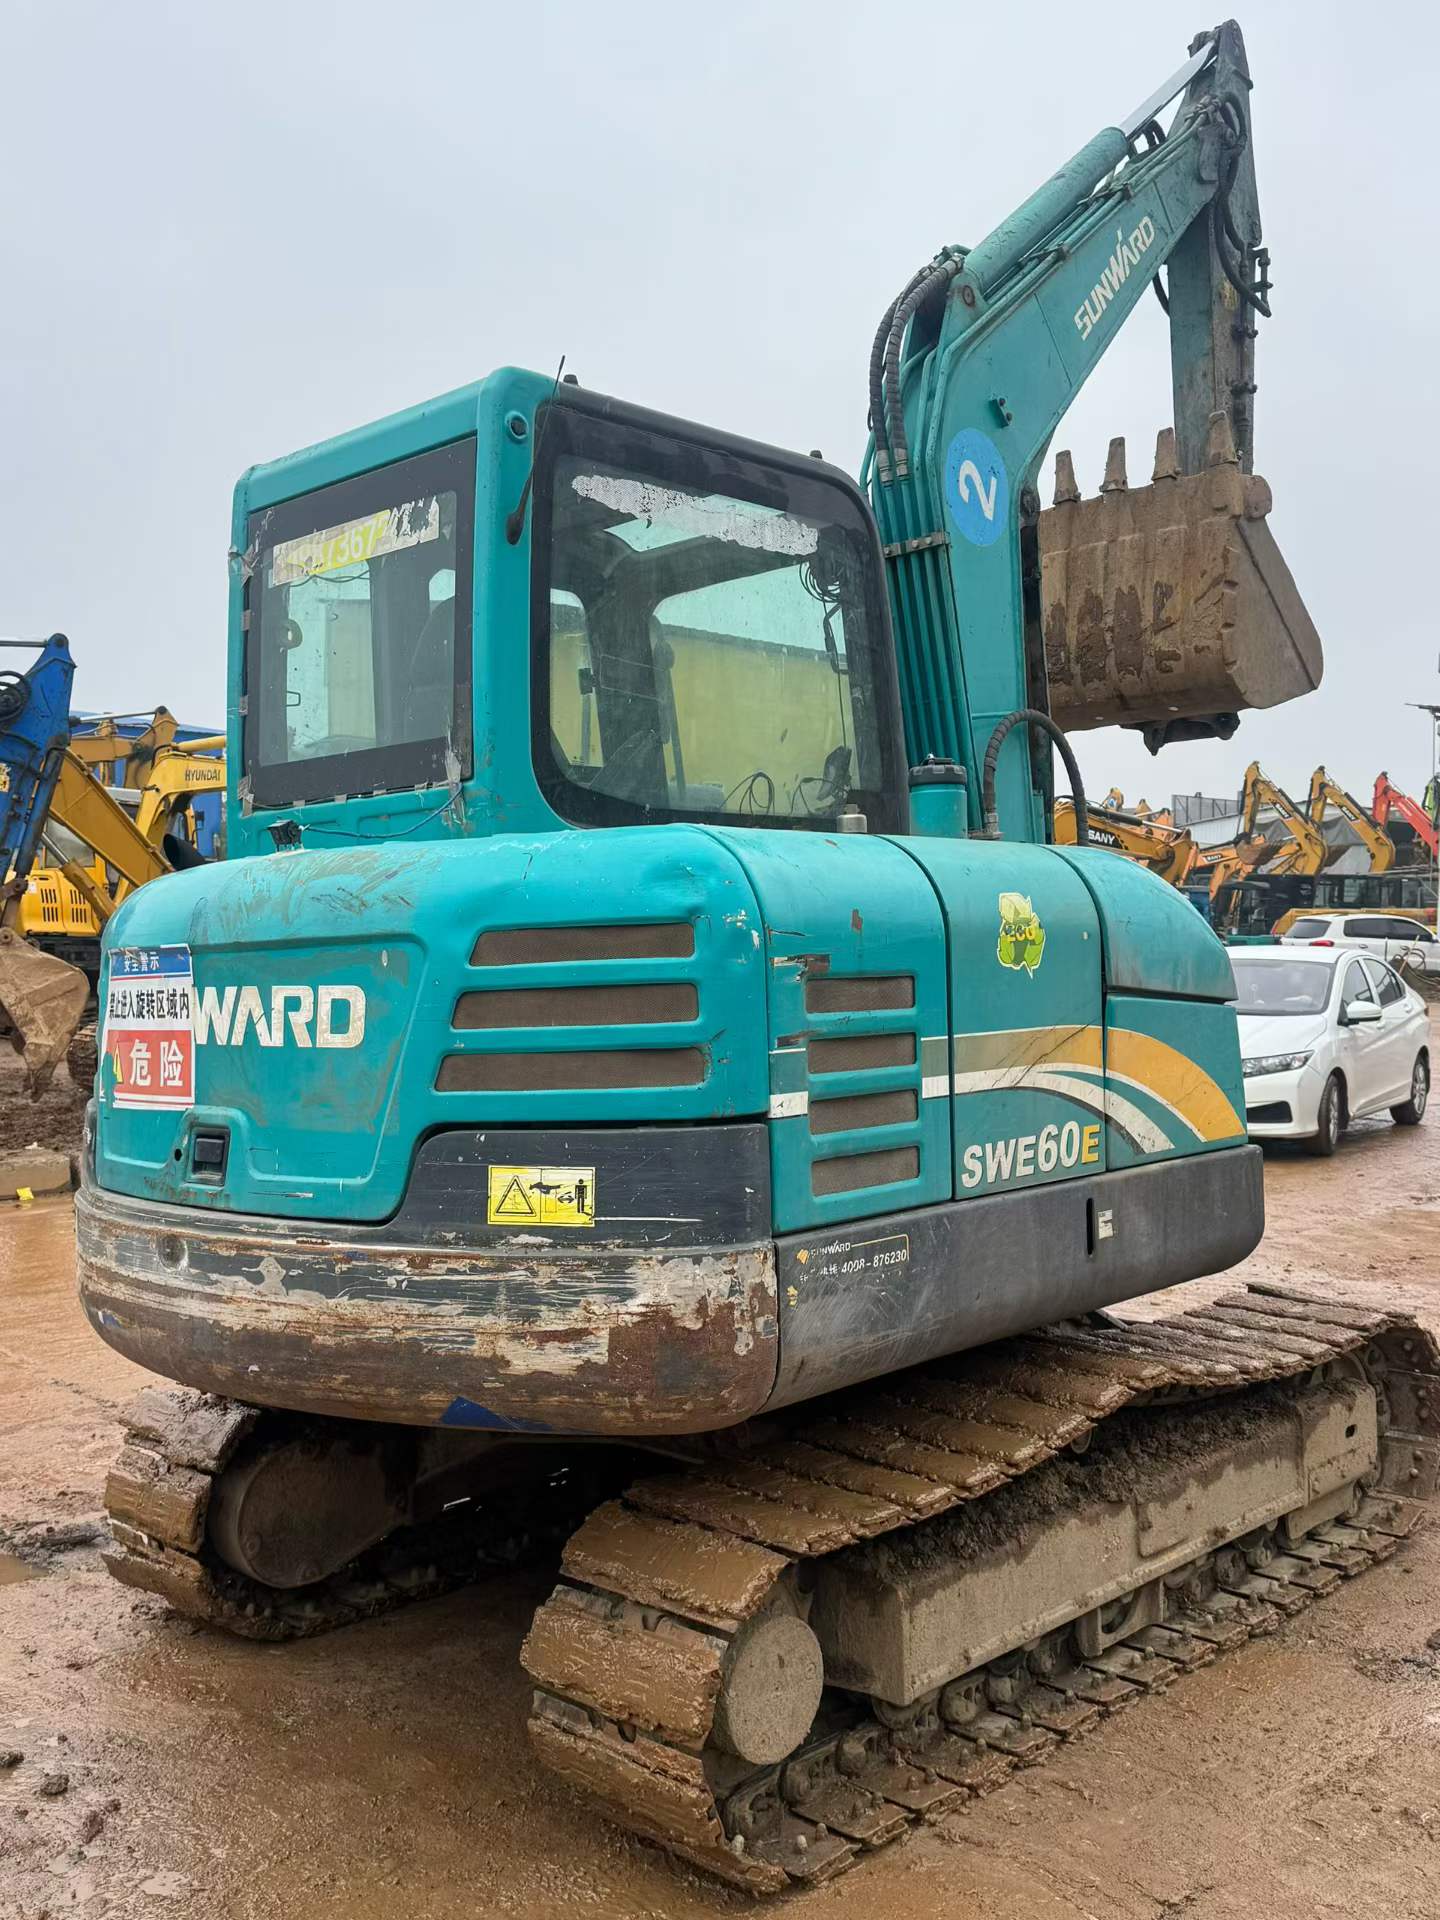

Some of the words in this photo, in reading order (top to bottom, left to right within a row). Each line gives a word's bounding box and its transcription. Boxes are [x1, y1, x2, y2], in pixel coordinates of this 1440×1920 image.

[1073, 215, 1155, 341] SUNWARD
[958, 459, 998, 521] 2
[185, 769, 221, 782] HYUNDAI
[1088, 829, 1116, 846] SANY
[129, 1038, 184, 1088] 危险
[961, 1119, 1102, 1190] SWE60E
